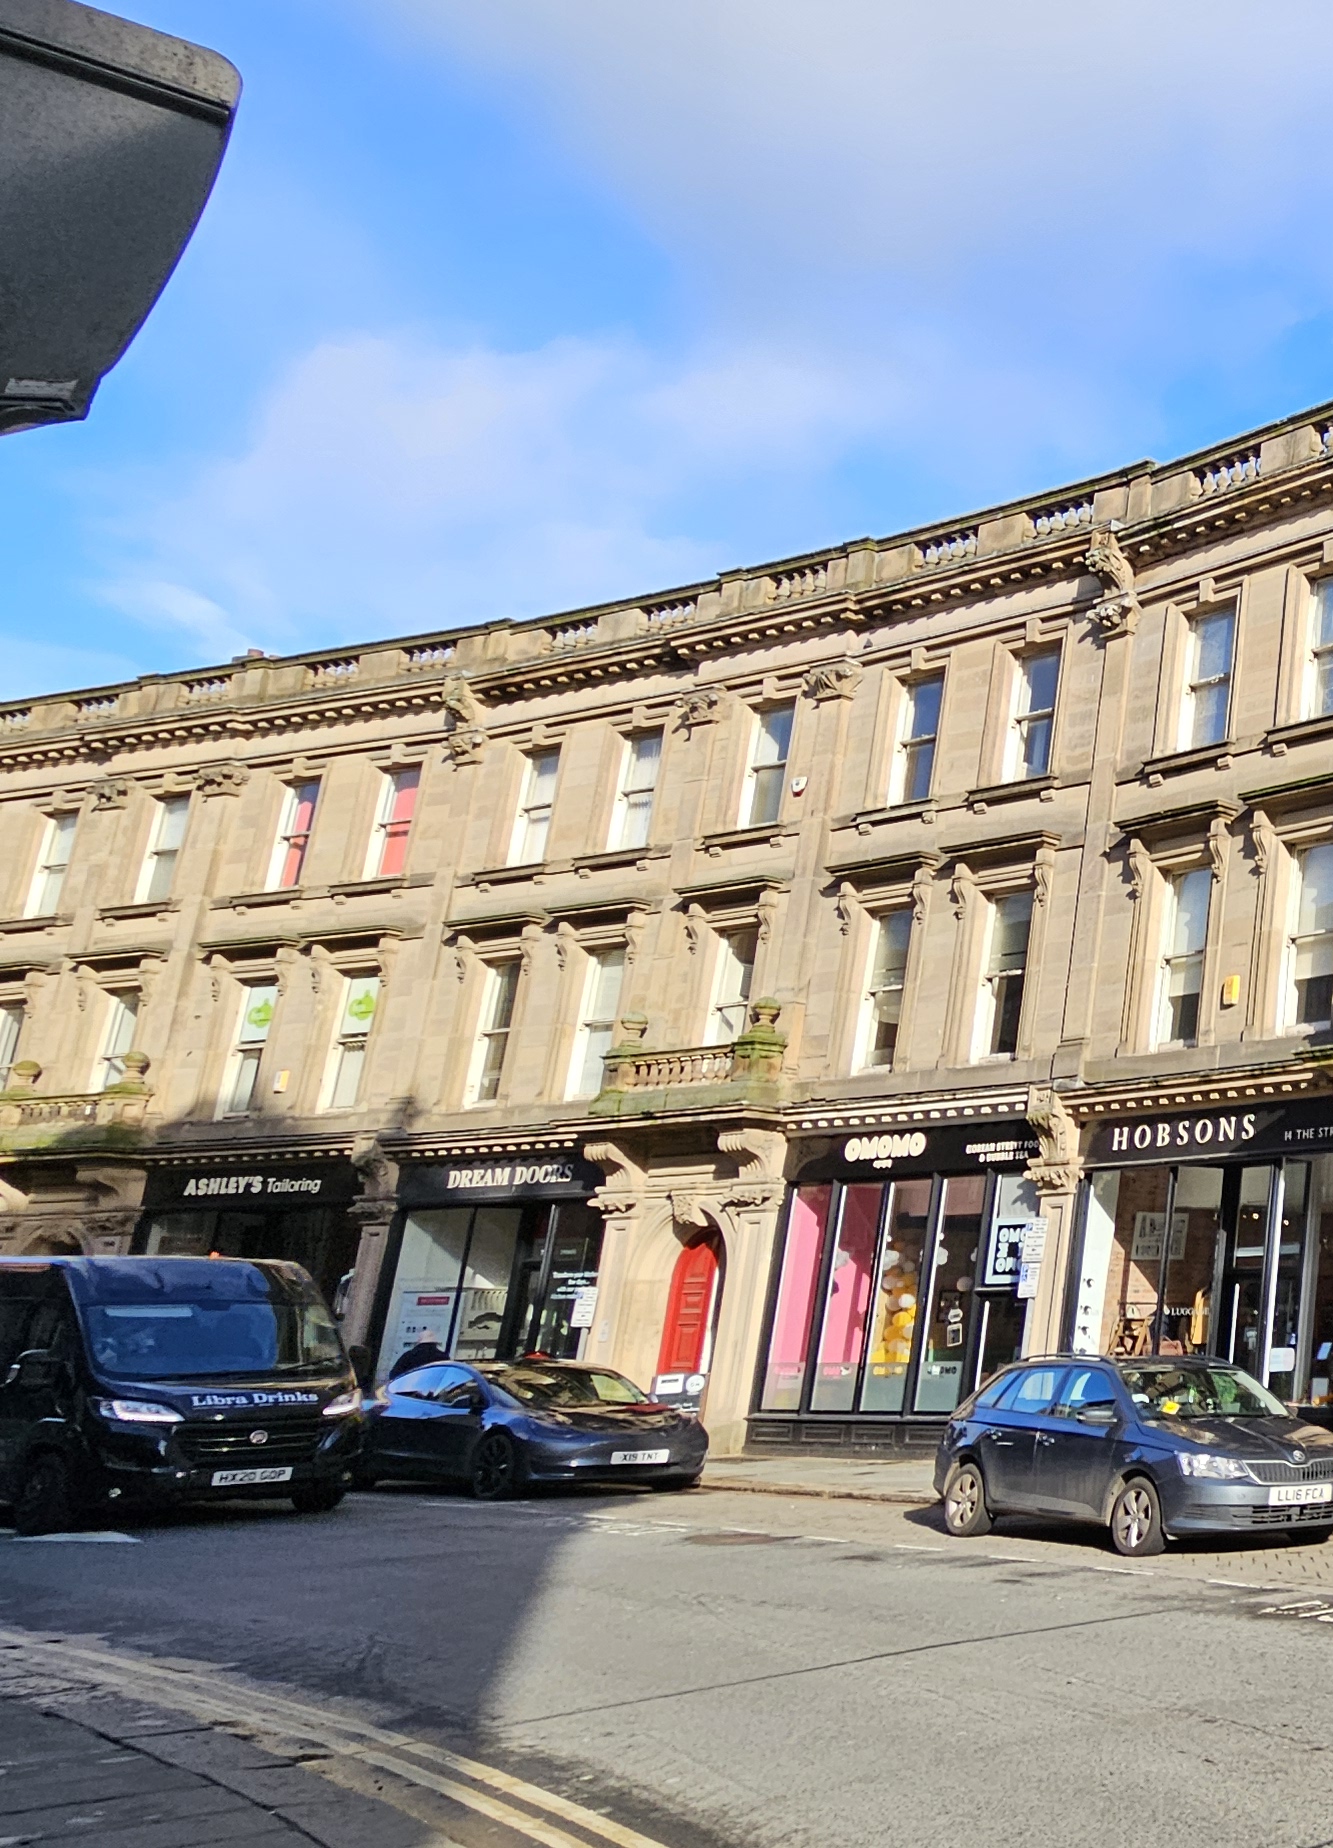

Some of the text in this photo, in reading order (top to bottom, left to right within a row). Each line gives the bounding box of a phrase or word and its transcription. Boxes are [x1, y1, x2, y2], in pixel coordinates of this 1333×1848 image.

[1111, 1113, 1257, 1151] HOBSONS
[1296, 1127, 1315, 1140] THE
[844, 1131, 927, 1162] OMOMO
[447, 1163, 575, 1189] DREAM DOORS
[183, 1175, 322, 1196] ASHLEY'S Tailoring
[1171, 1307, 1210, 1316] LUGGE
[191, 1394, 249, 1407] Libra
[253, 1391, 319, 1404] Drinks
[1277, 1487, 1325, 1502] LL16 FCA
